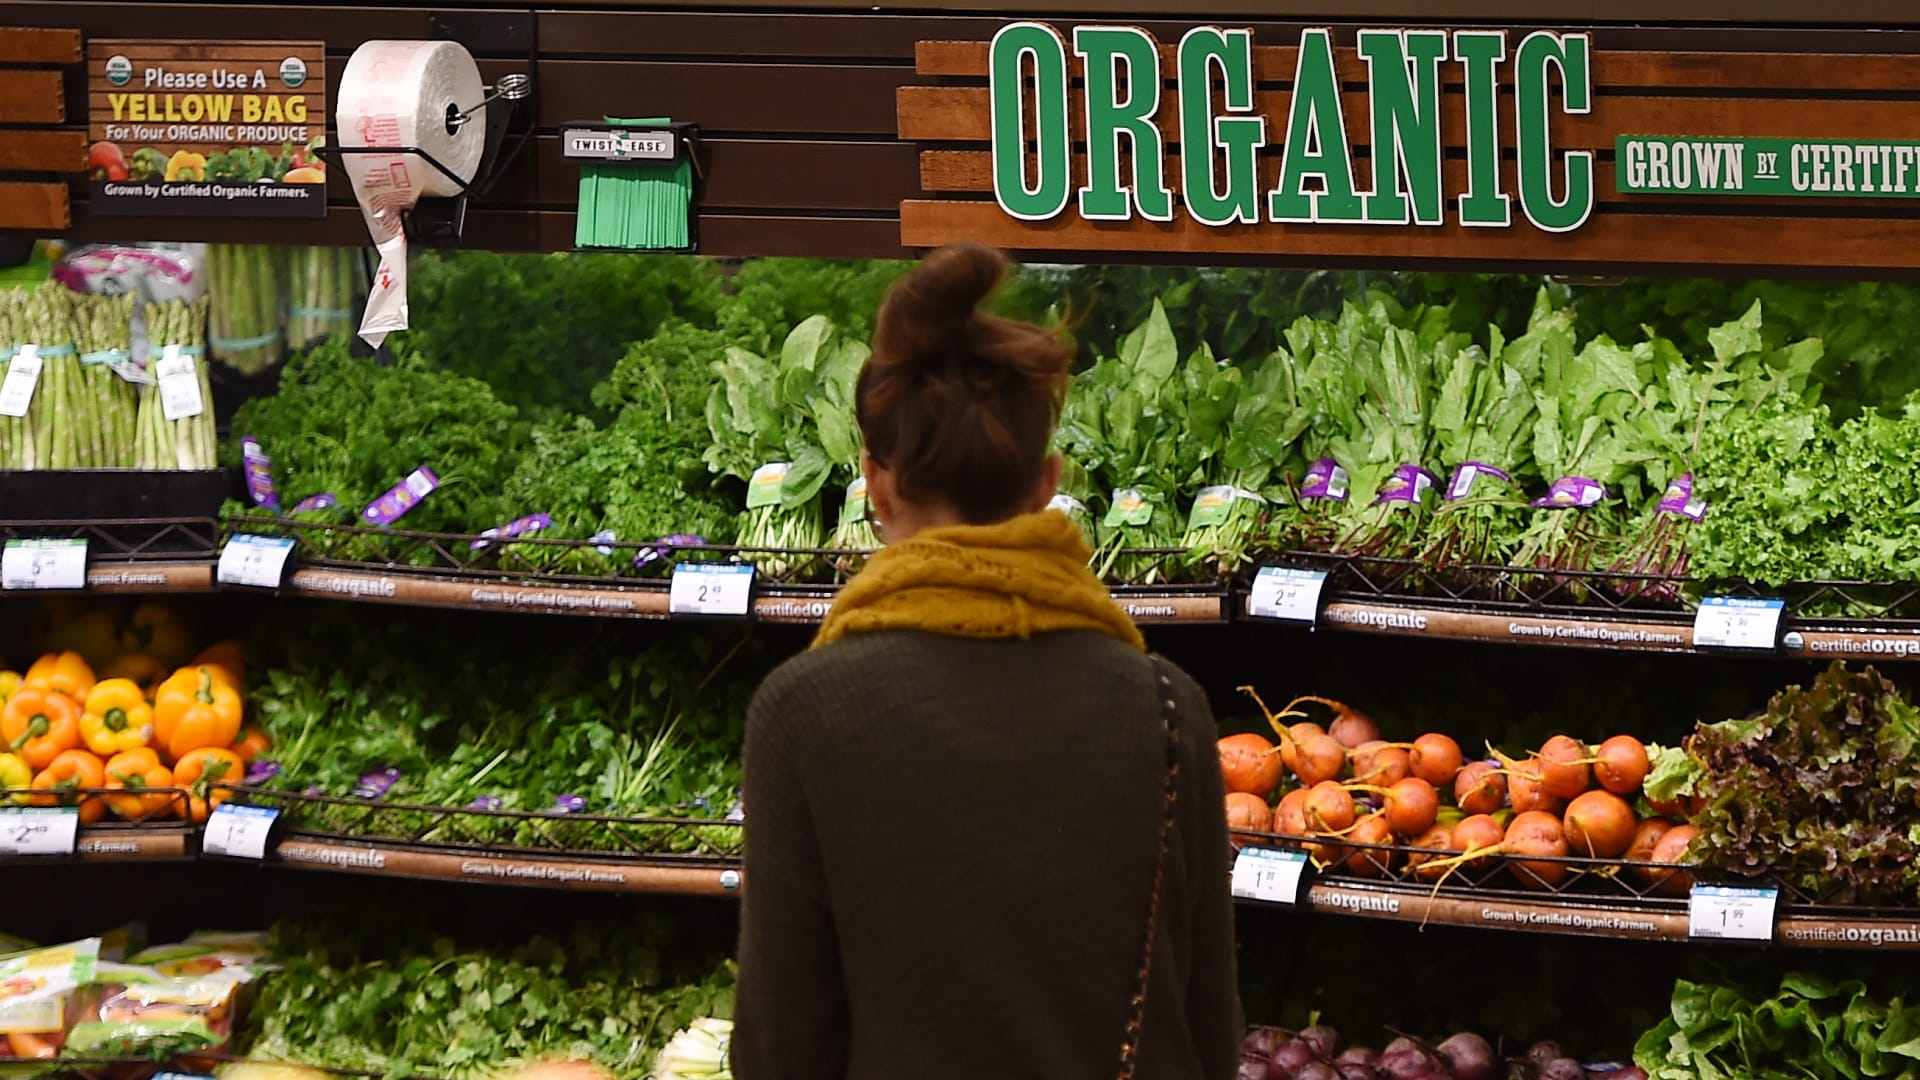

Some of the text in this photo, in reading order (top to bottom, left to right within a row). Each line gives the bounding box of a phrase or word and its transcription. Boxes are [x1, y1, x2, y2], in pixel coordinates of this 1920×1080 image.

[145, 67, 208, 88] Please
[212, 69, 248, 88] Use
[252, 69, 267, 88] A
[107, 93, 307, 123] YELLOW BAG
[106, 125, 307, 142] For Your ORGANIC PRODUCE
[988, 22, 1593, 232] ORGANIC
[575, 140, 612, 151] TWIST
[1626, 140, 1744, 190] GROWN
[1757, 152, 1778, 175] BY
[105, 183, 309, 199] Grown by Certified Organic Farmers.
[88, 574, 121, 586] rganic
[698, 585, 707, 602] 2
[1275, 589, 1284, 606] 2
[1509, 623, 1541, 636] Grown
[1542, 625, 1555, 639] by
[1556, 625, 1598, 639] Certified
[1599, 628, 1641, 642] Organic
[1482, 908, 1657, 931] Grown by Certified Organic Farmers.
[1720, 908, 1727, 927] 1
[1786, 925, 1920, 946] certifiedorgani
